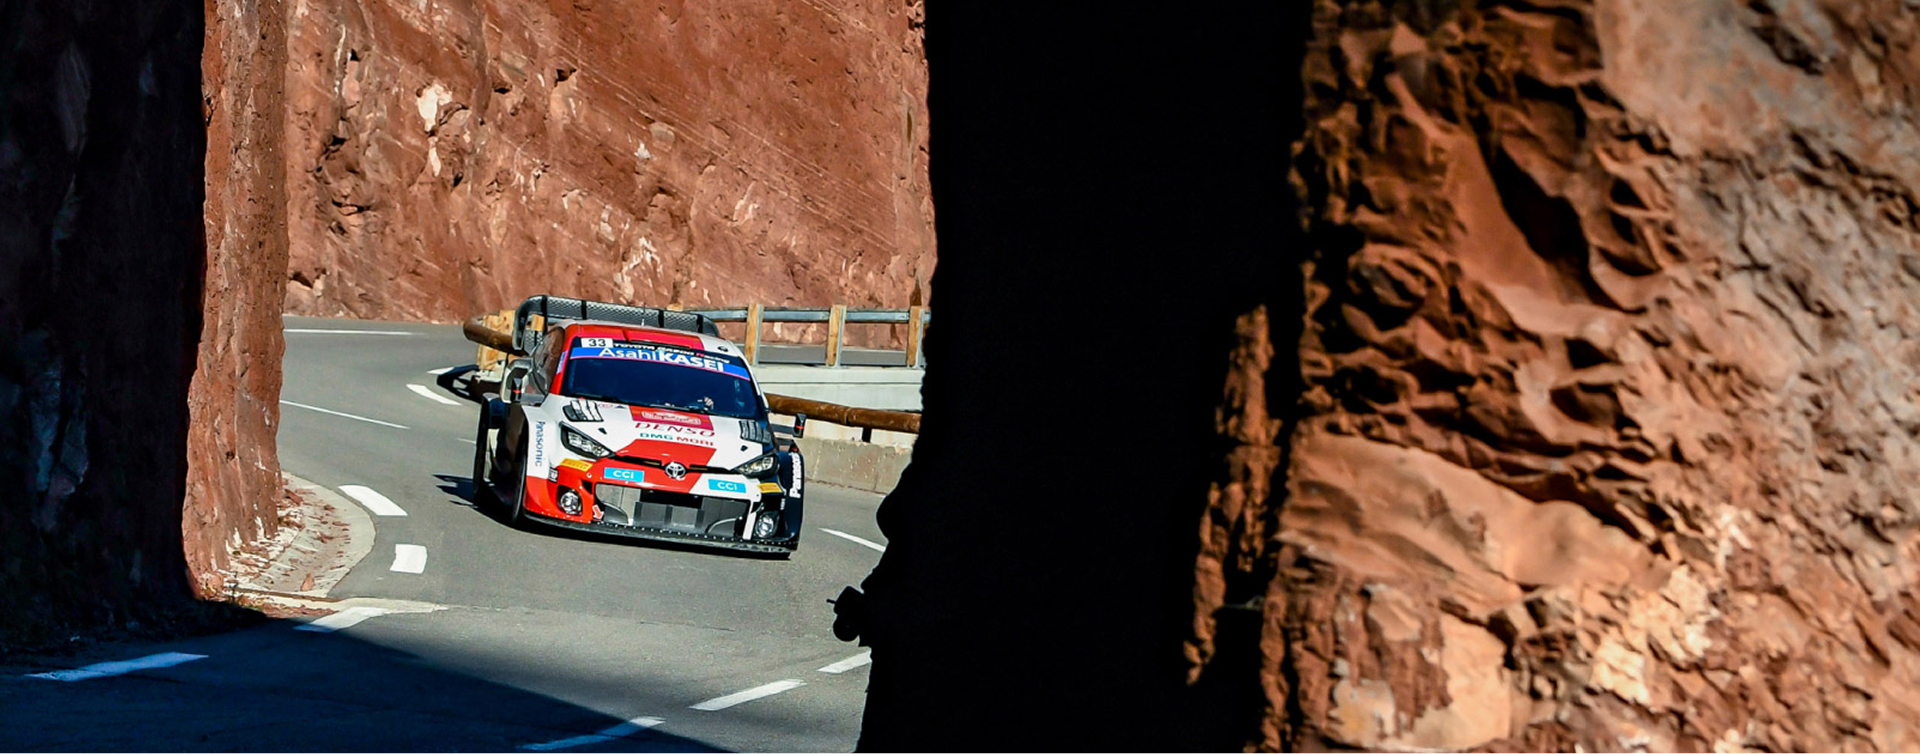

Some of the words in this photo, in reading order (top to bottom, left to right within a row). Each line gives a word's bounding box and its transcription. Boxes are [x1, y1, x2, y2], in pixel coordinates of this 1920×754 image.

[588, 339, 607, 347] 33
[613, 342, 655, 351] TOYOTA
[635, 422, 716, 437] DENSO
[640, 432, 674, 441] DMG
[676, 436, 715, 446] MORI
[613, 468, 635, 480] CCI
[717, 482, 738, 491] CCI
